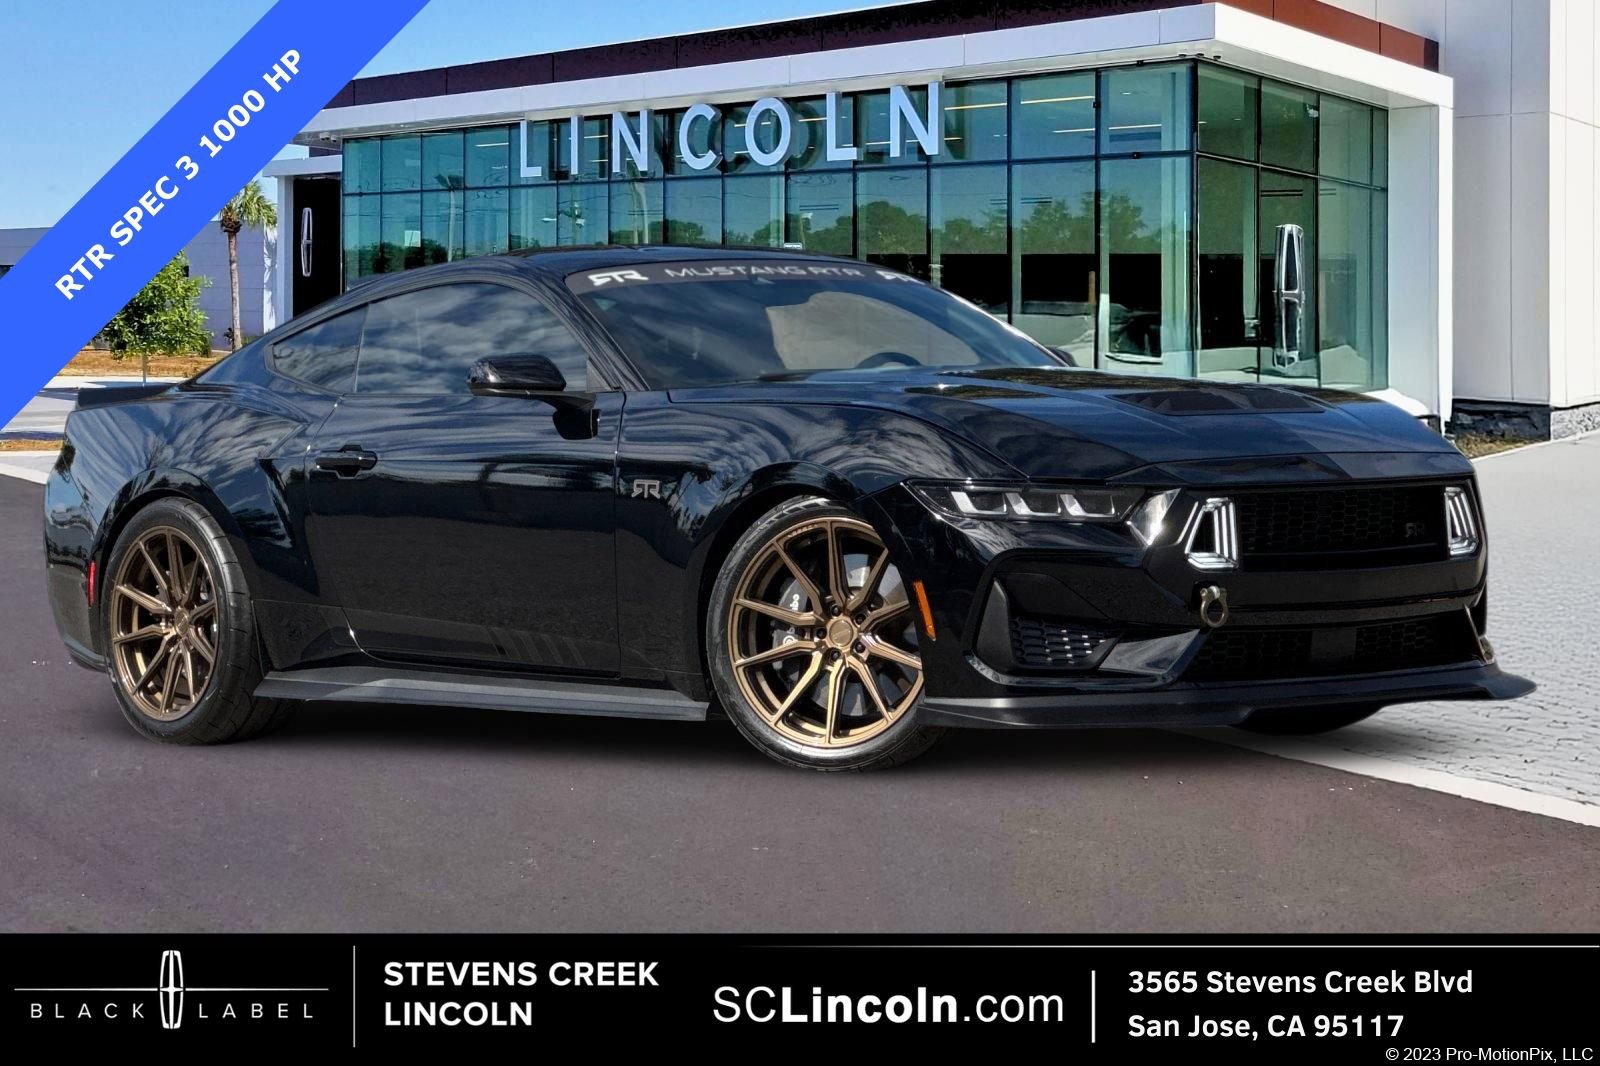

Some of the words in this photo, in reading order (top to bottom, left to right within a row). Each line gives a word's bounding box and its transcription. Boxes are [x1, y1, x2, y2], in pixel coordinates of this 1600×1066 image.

[519, 81, 943, 178] LINCOLN
[663, 265, 807, 277] MUSTANG
[807, 266, 865, 277] RTR
